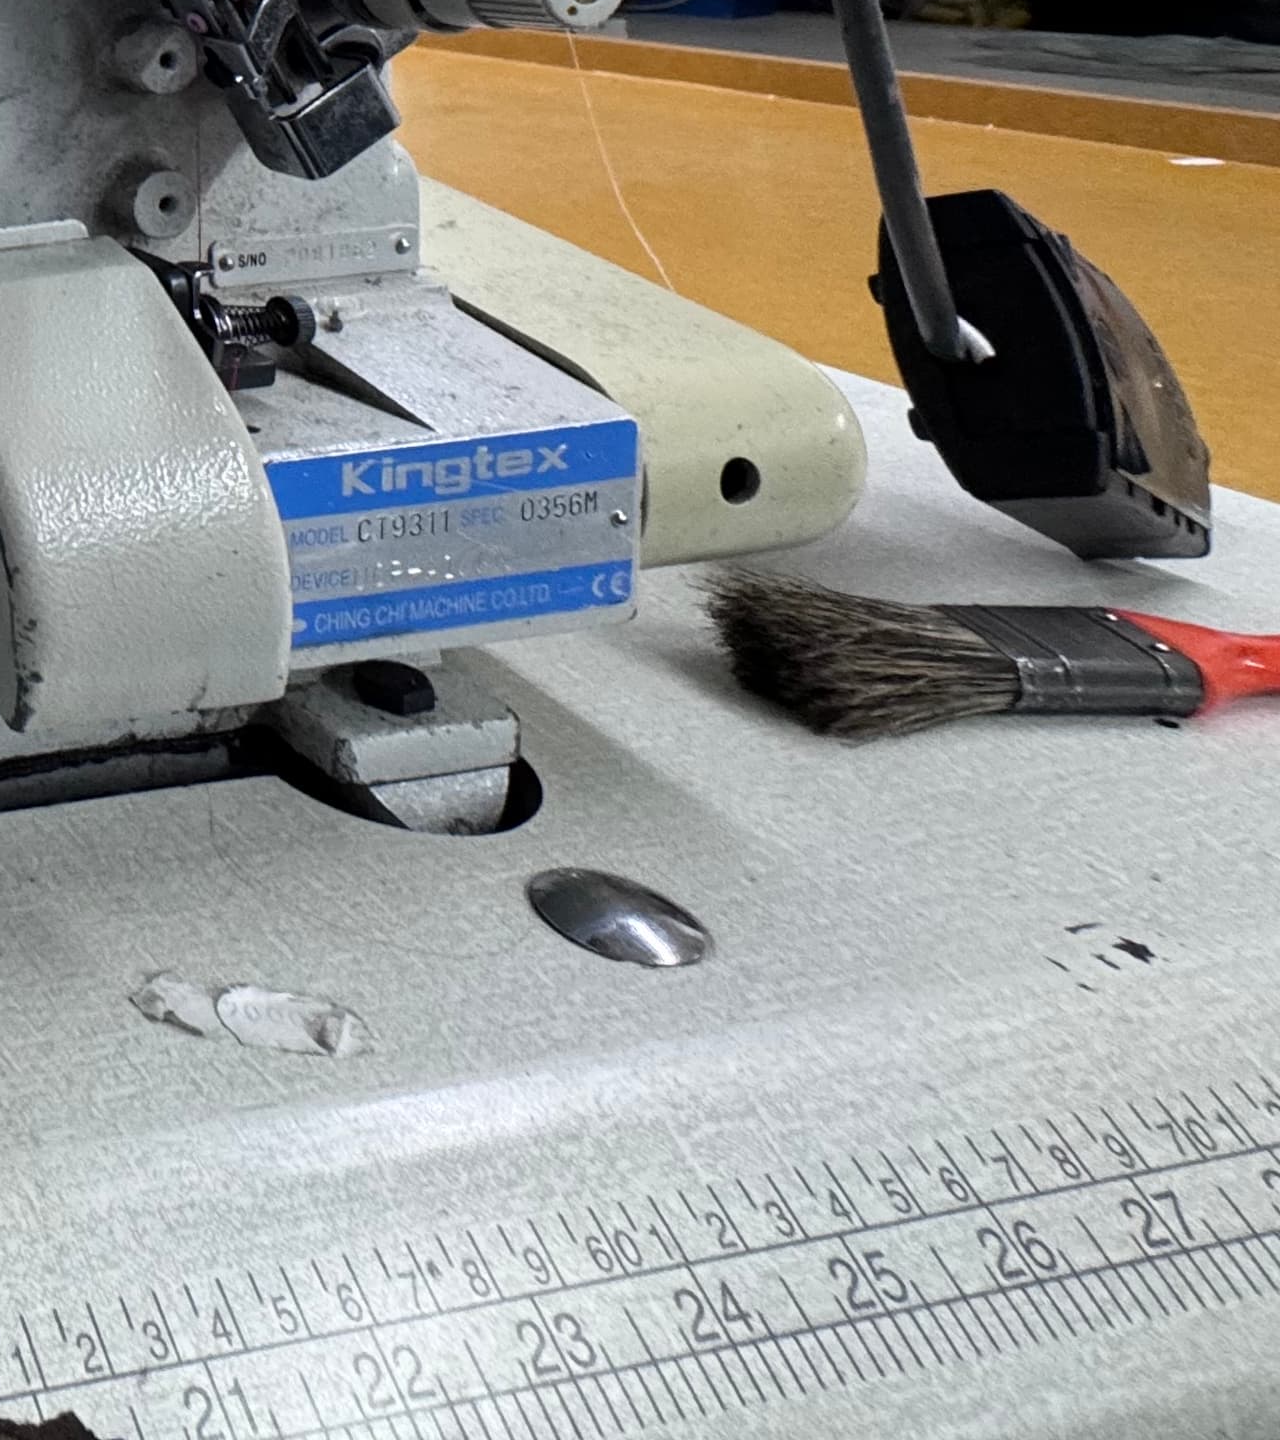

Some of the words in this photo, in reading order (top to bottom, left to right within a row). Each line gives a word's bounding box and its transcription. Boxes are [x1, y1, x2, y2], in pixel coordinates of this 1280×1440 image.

[237, 251, 268, 269] S/NO
[342, 442, 569, 497] Kingtex
[291, 525, 350, 549] MODEL
[356, 510, 451, 544] CT9311
[519, 490, 600, 523] 0356M
[314, 611, 371, 635] CHING
[408, 591, 487, 622] MACHINE
[11, 1345, 31, 1385] 1
[76, 1332, 103, 1374] 2
[142, 1320, 170, 1361] 3
[211, 1308, 233, 1347] 4
[271, 1295, 298, 1335] 5
[337, 1283, 364, 1322] 6
[397, 1271, 423, 1311] 7
[461, 1259, 491, 1298] 8
[523, 1247, 552, 1286] 9
[585, 1229, 643, 1273] 60
[648, 1224, 674, 1261] 1
[705, 1212, 738, 1250] 2
[764, 1200, 796, 1238] 3
[827, 1187, 855, 1225] 4
[879, 1177, 913, 1215] 5
[938, 1166, 970, 1203] 6
[990, 1155, 1021, 1193] 7
[1048, 1144, 1082, 1180] 8
[1102, 1133, 1136, 1171] 9
[1156, 1117, 1218, 1157] 70
[1215, 1111, 1247, 1146] 1
[183, 1376, 259, 1440] 21
[352, 1344, 437, 1409] 22
[516, 1312, 598, 1376] 23
[674, 1280, 755, 1343] 24
[828, 1250, 909, 1311] 25
[977, 1220, 1058, 1281] 26
[1120, 1189, 1196, 1249] 27
